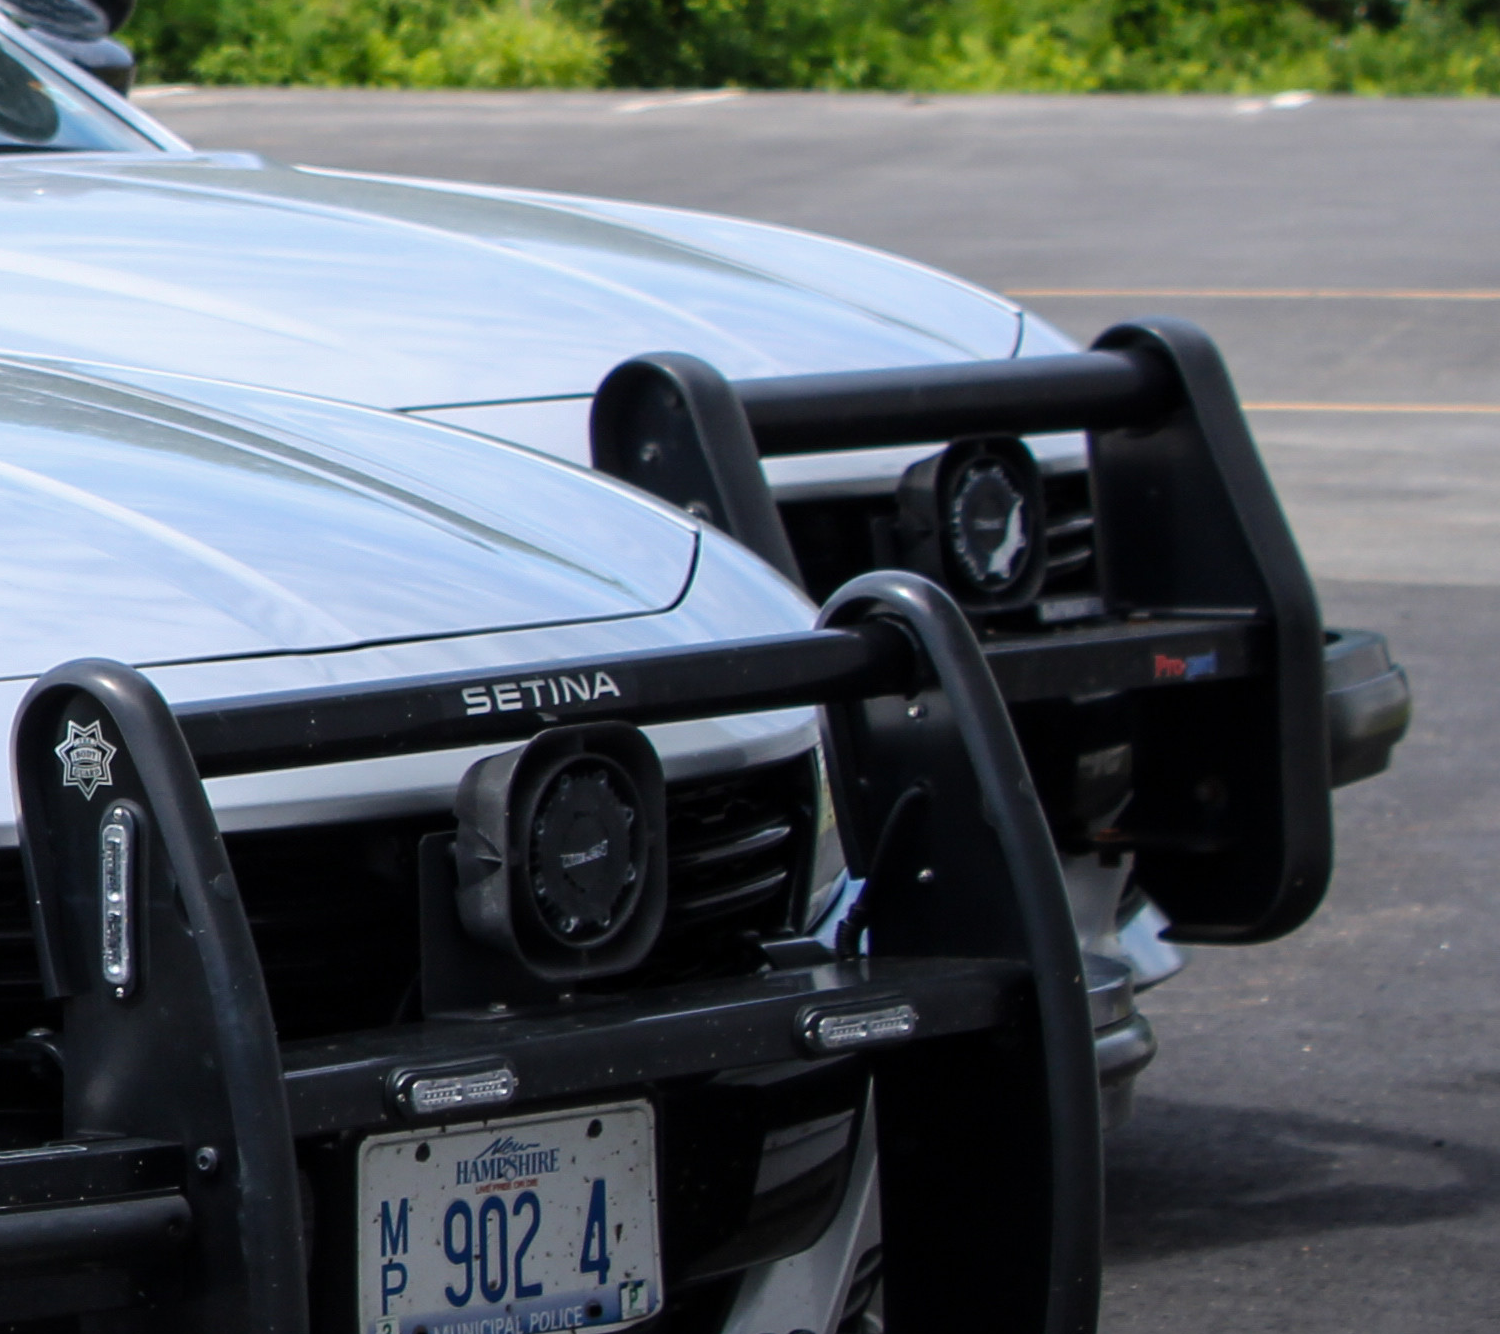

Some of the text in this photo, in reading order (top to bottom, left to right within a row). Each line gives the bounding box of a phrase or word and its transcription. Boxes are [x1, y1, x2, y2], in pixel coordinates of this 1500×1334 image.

[461, 671, 621, 716] SETINA
[475, 1136, 540, 1160] New
[456, 1148, 560, 1185] HAMPSHIRE
[528, 1305, 584, 1332] POLICE
